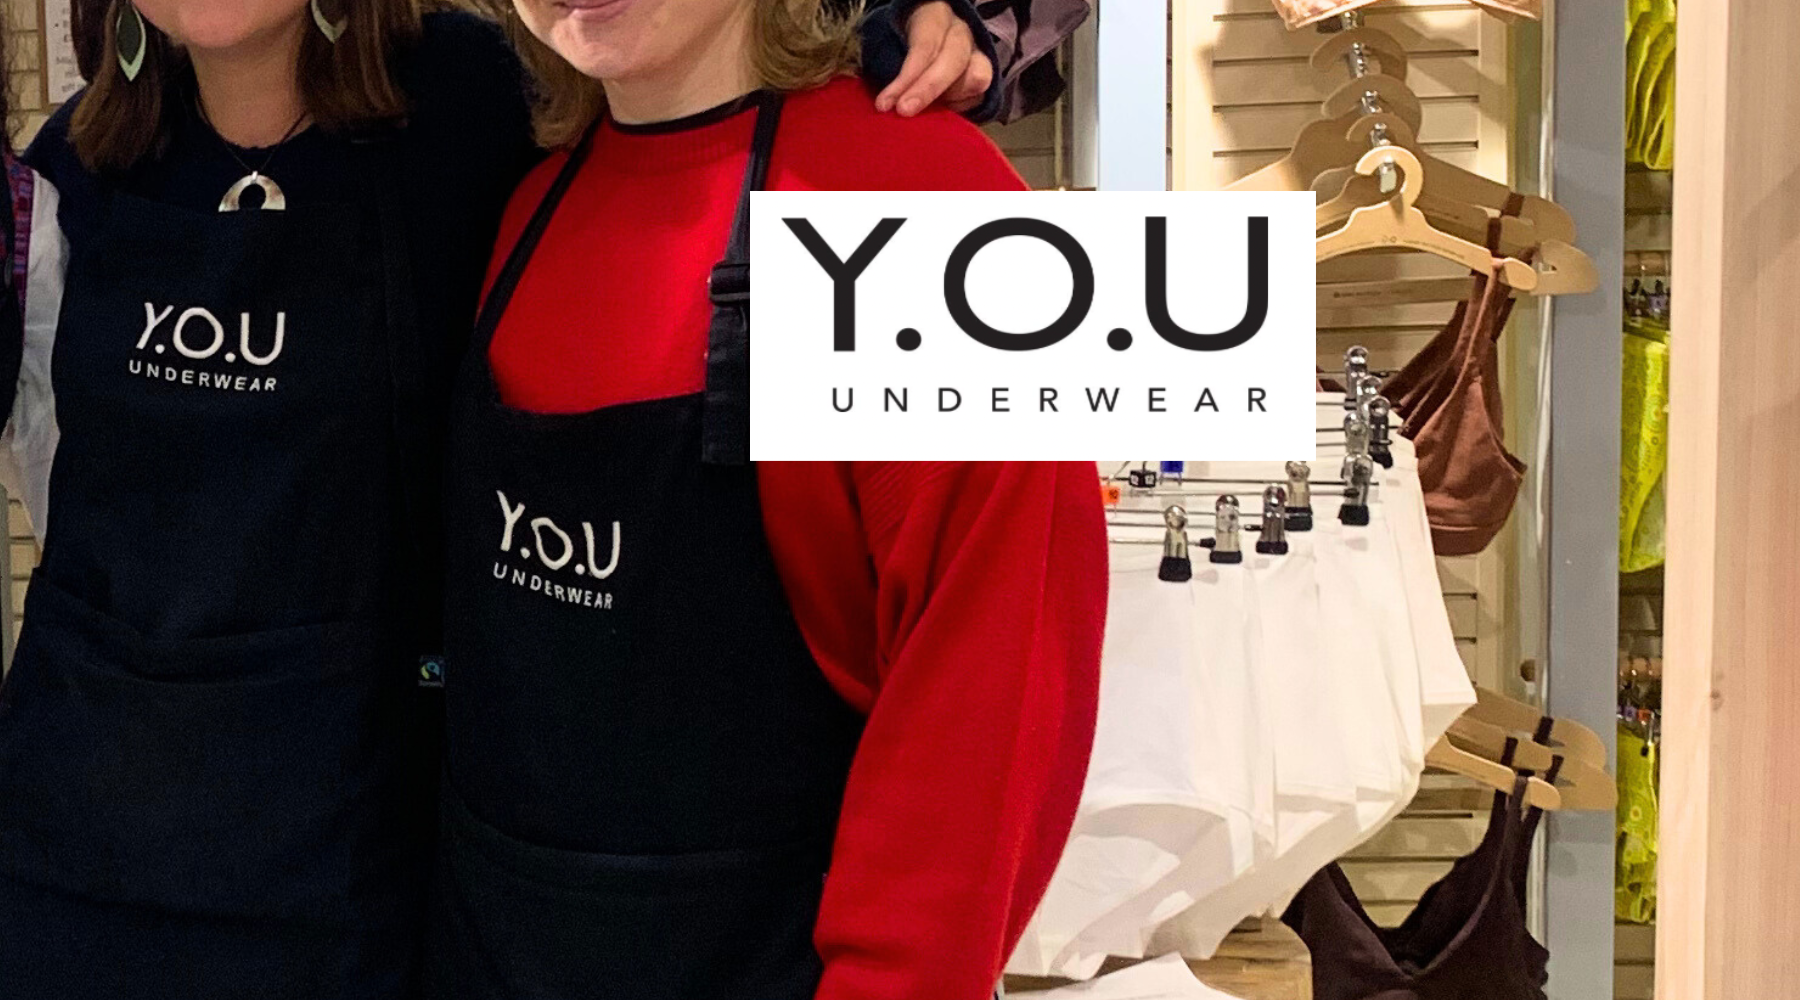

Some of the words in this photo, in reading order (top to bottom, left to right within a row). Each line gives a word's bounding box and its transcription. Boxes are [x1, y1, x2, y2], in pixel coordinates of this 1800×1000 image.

[135, 302, 286, 366] Y.O.U
[128, 359, 278, 392] UNDERWEAR
[496, 489, 621, 580] Y.O.U
[493, 562, 614, 610] UNDERWEAR
